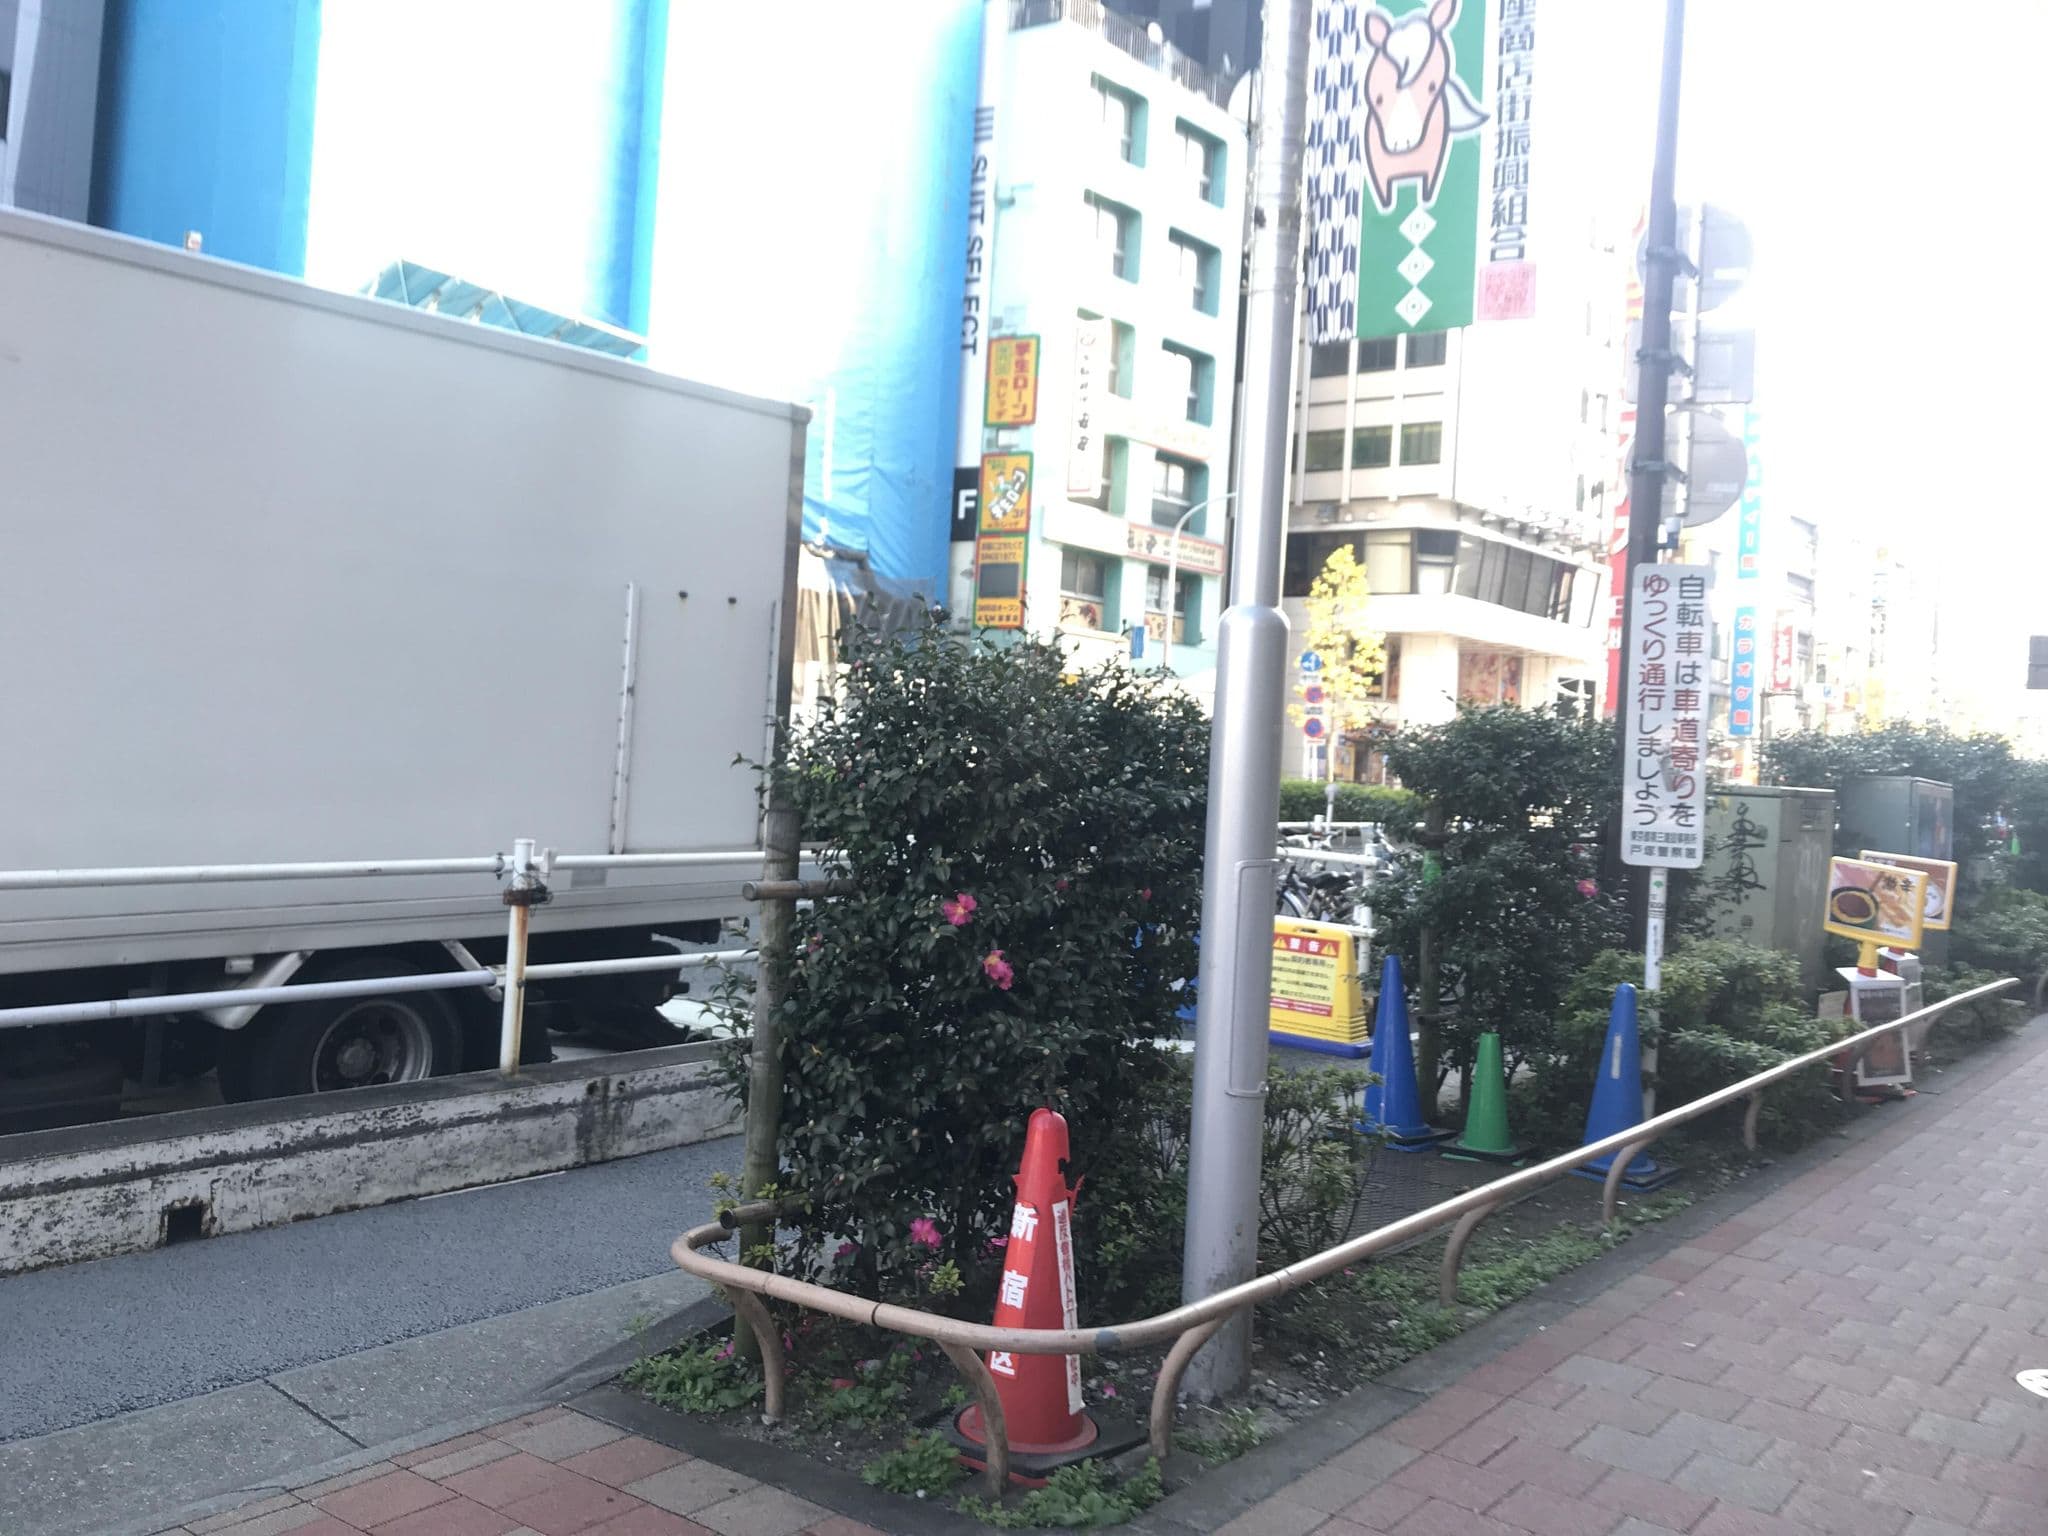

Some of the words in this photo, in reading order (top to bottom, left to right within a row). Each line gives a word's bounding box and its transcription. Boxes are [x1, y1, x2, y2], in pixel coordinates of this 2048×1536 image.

[958, 489, 978, 519] F
[1633, 574, 1670, 826] ゆっくり通行しましょう
[1669, 574, 1705, 827] 自転車は車道寄りを
[989, 1202, 1039, 1377] 新宿区
